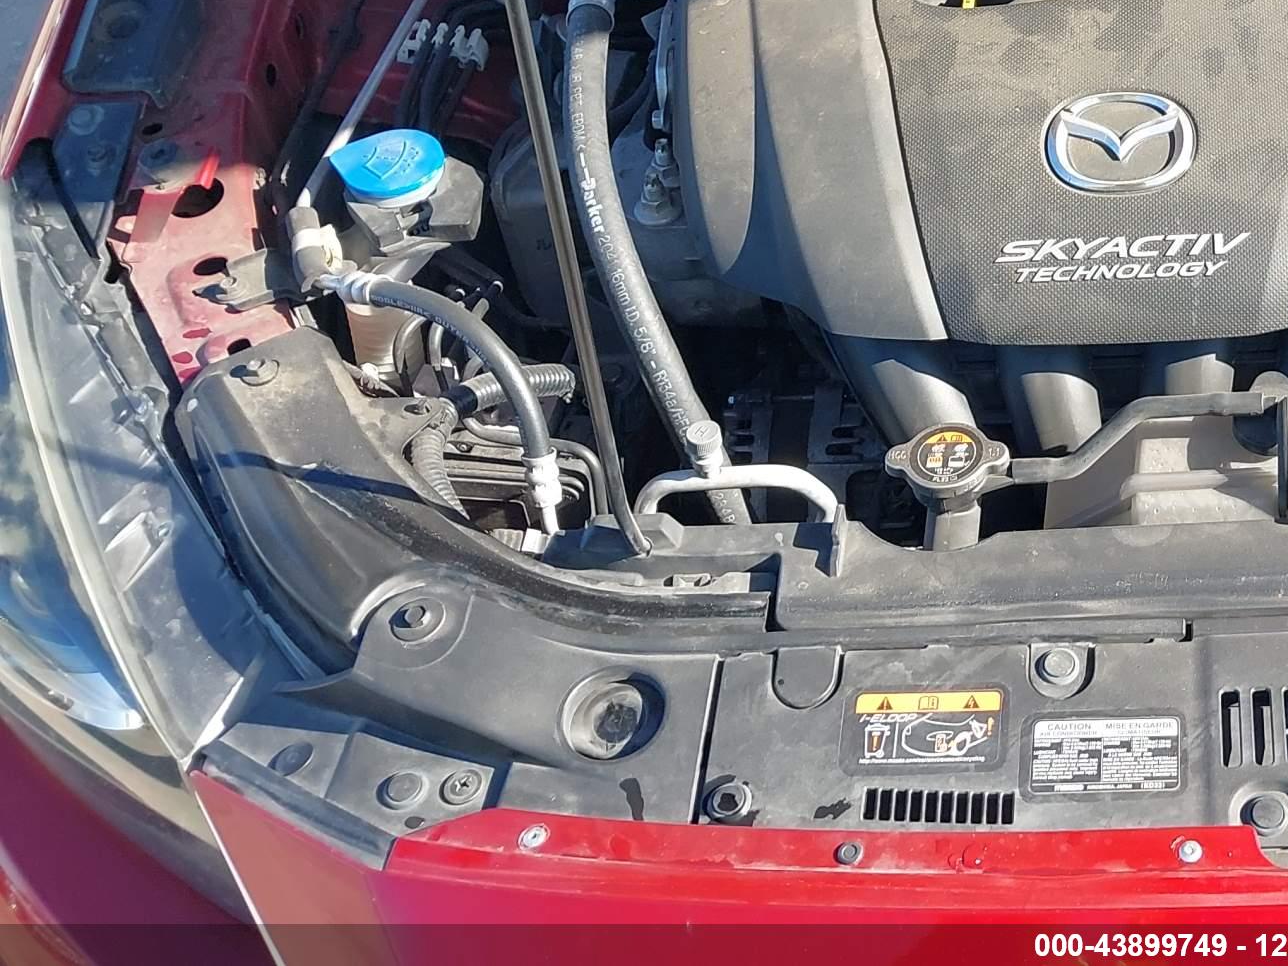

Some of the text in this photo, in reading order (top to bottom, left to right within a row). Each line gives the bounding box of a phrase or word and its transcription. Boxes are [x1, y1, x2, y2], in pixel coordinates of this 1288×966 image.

[580, 177, 605, 233] Parker
[611, 268, 631, 305] 16mm
[994, 233, 1250, 263] SKYACTIV
[1016, 260, 1228, 283] TECHNOLOGY
[1047, 722, 1092, 731] CAUTION
[1143, 721, 1173, 729] GARDE
